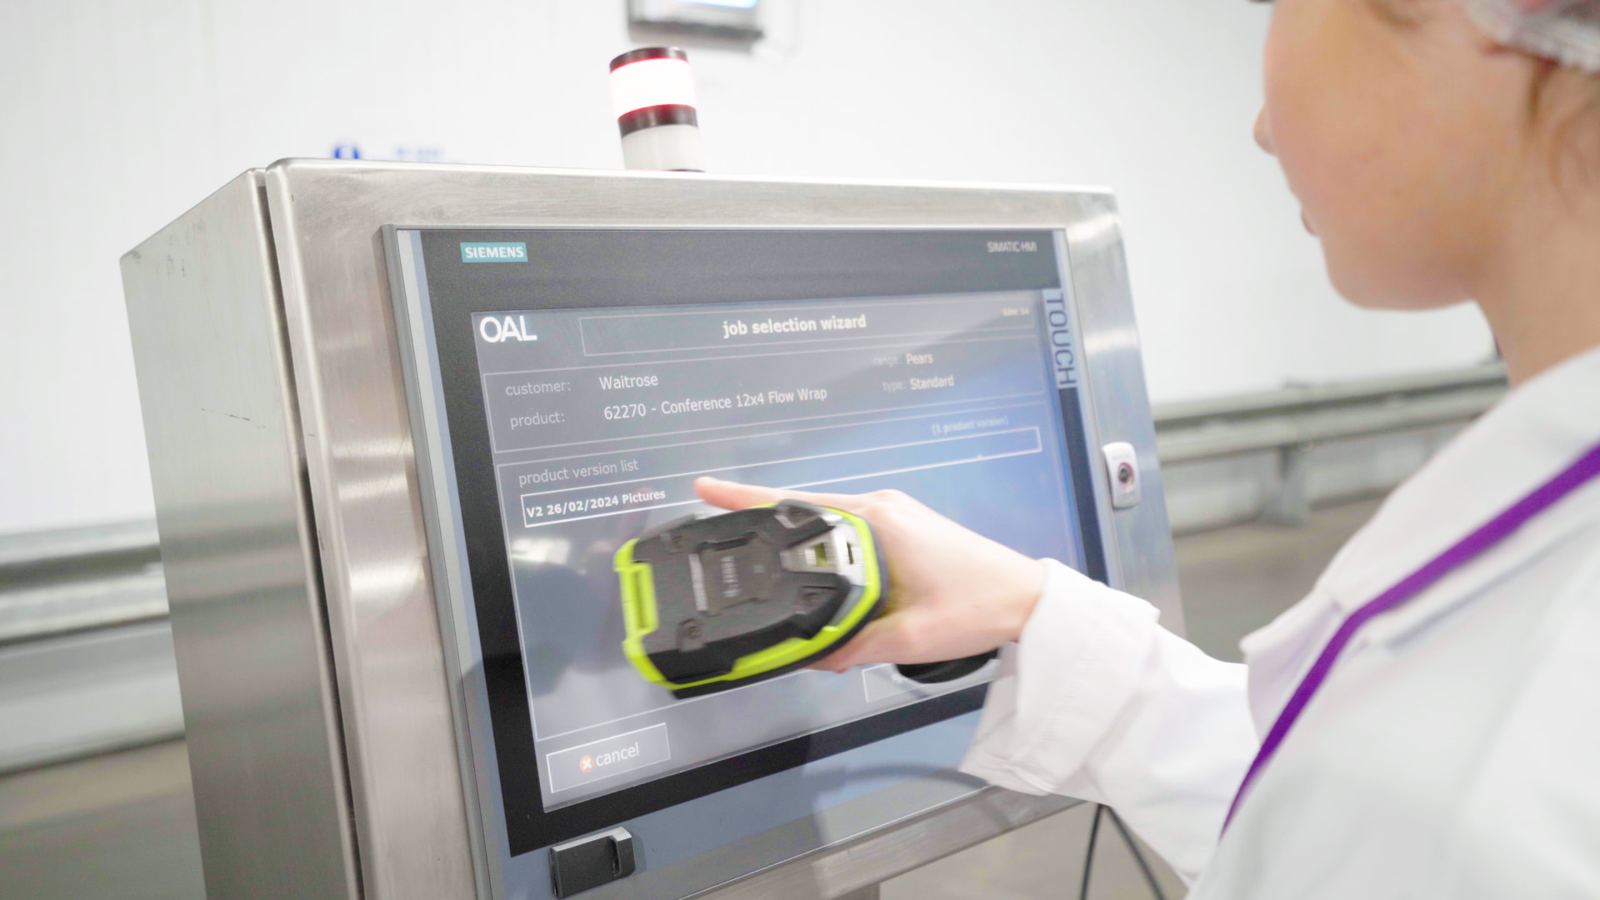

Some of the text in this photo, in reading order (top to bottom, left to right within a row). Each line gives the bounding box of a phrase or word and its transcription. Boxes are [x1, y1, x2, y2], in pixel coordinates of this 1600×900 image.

[465, 247, 524, 259] SIEMENS
[479, 315, 538, 343] OAL
[723, 314, 867, 339] job selection wizard
[1046, 292, 1077, 385] TOUCH
[905, 352, 934, 365] Pears
[505, 380, 572, 396] customer:
[599, 374, 659, 390] Waitrose
[910, 375, 955, 391] Standard
[603, 403, 647, 421] 62270
[661, 396, 732, 415] Conference
[736, 392, 764, 409] 12x4
[768, 390, 794, 405] Flow
[797, 388, 828, 403] Wrap
[510, 411, 566, 430] product:
[518, 458, 640, 488] product version list
[526, 489, 666, 518] V2 26/02/2024 Pictures
[595, 742, 641, 768] cancel
